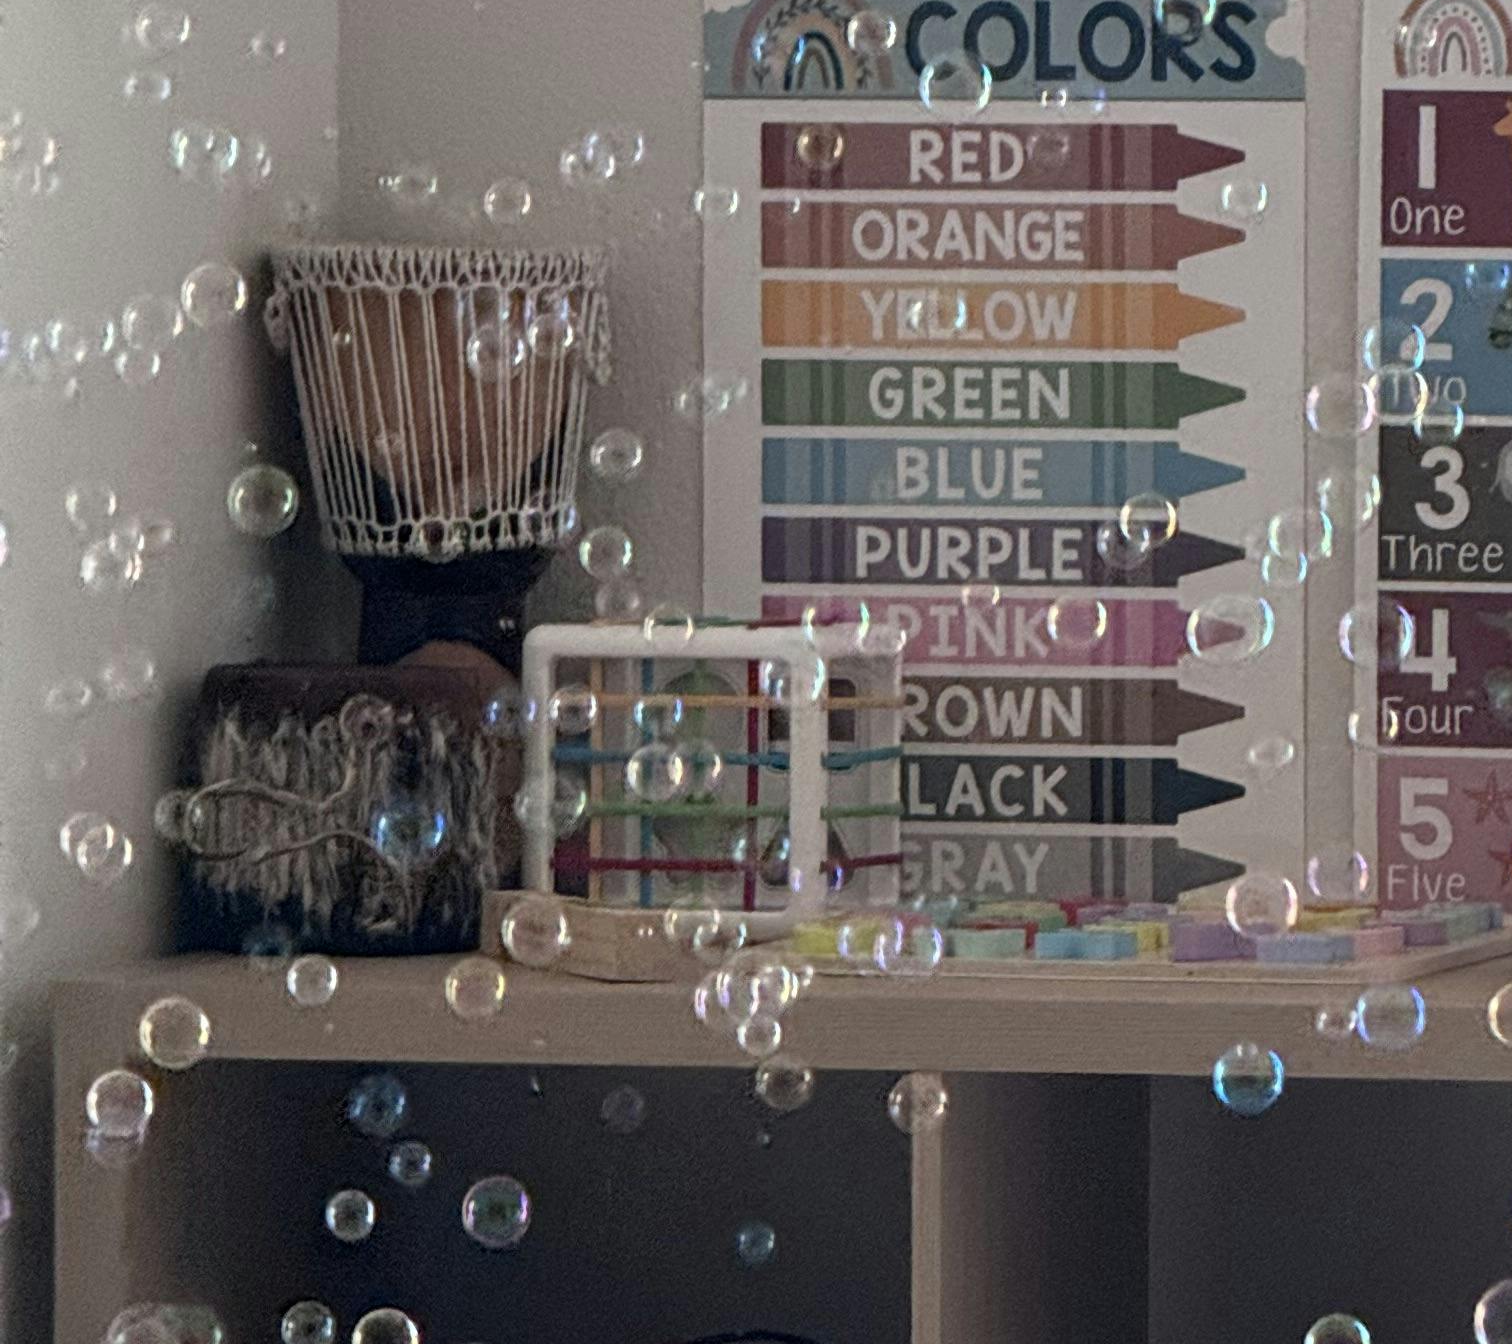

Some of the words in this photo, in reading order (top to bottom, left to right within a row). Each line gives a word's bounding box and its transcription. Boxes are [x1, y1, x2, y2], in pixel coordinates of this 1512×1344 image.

[905, 0, 1258, 84] COLORS
[909, 129, 1025, 184] RED
[1418, 105, 1437, 189] 1
[852, 209, 1085, 261] ORANGE
[1390, 197, 1466, 235] One
[860, 289, 1078, 341] YELLOW
[1400, 277, 1454, 361] 2
[868, 366, 1071, 420] GREEN
[896, 446, 1043, 500] BLUE
[1414, 445, 1470, 531] 3
[855, 525, 1083, 580] PURPLE
[1380, 534, 1505, 573] Three
[887, 603, 1050, 658] PINK
[1399, 609, 1457, 692] 4
[901, 683, 1083, 738] ROWN
[1381, 697, 1473, 736] Four
[907, 768, 1068, 818] LACK
[1399, 777, 1453, 861] 5
